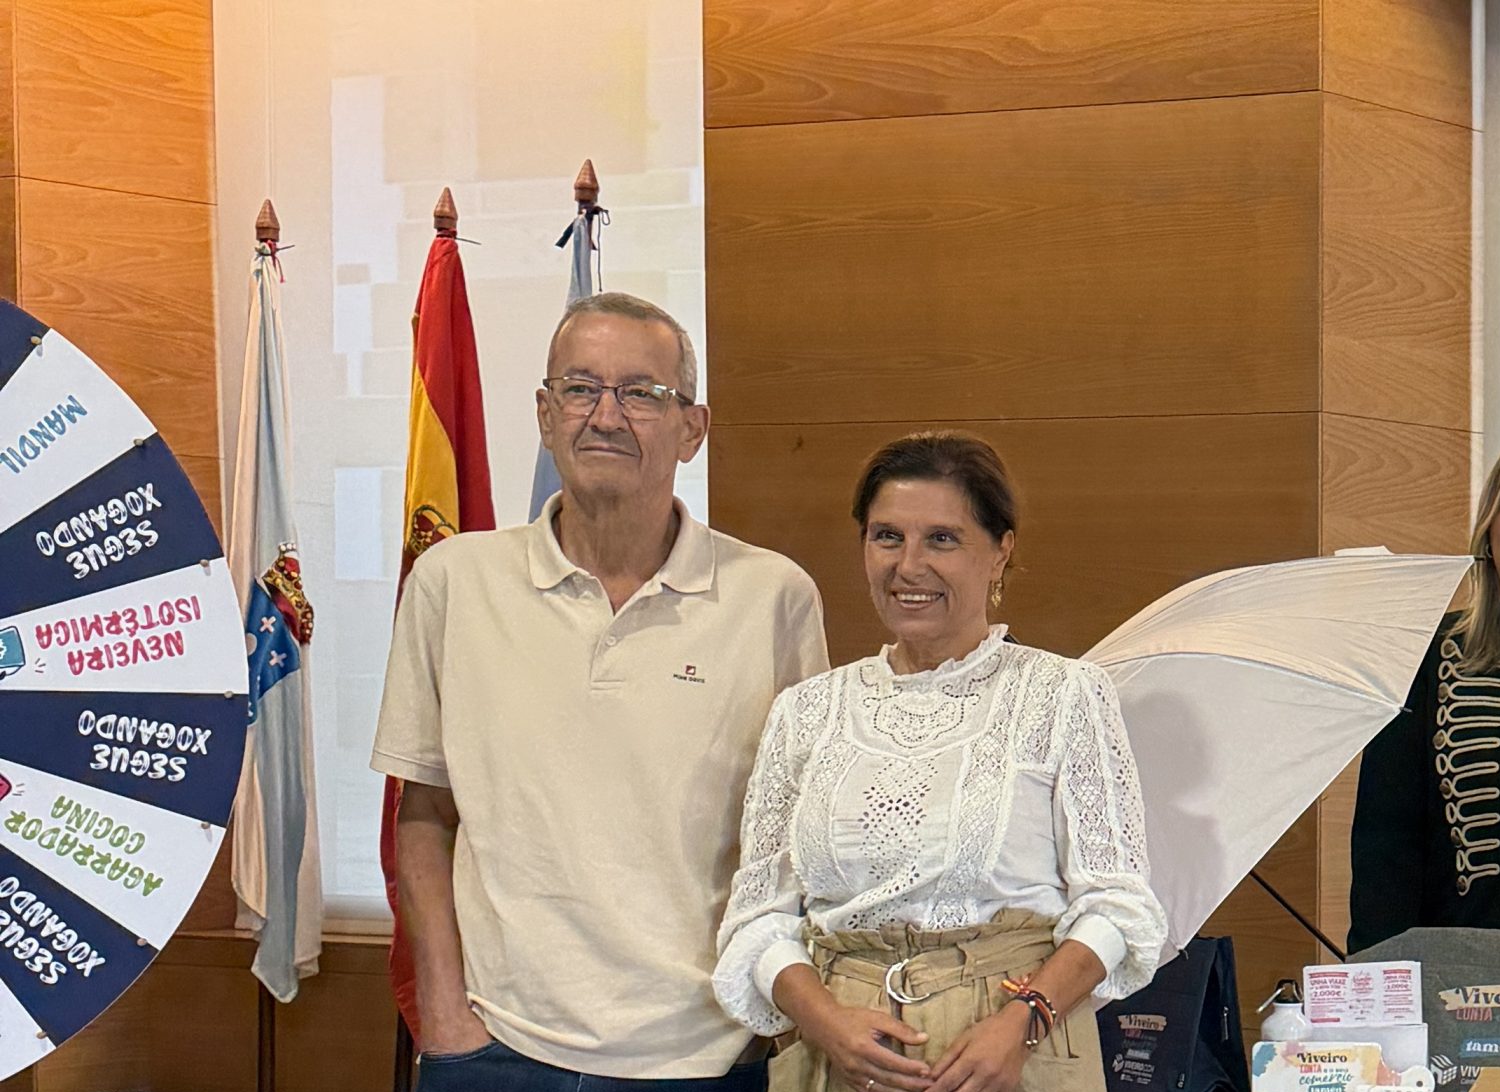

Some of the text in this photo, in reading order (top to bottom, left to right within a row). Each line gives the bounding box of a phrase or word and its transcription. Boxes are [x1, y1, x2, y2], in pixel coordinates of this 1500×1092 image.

[0, 394, 88, 475] MANDIL
[35, 482, 163, 557] XOGANDO
[66, 519, 160, 580] SEGUE
[67, 630, 185, 676] NEVEIRA
[78, 709, 212, 755] XOGANDO
[89, 743, 188, 782] SEGUE
[4, 809, 163, 898] AGARRADOR
[50, 794, 146, 855] COCIÑA
[0, 876, 106, 977] XOGANDO
[1297, 1053, 1347, 1063] Viveiro
